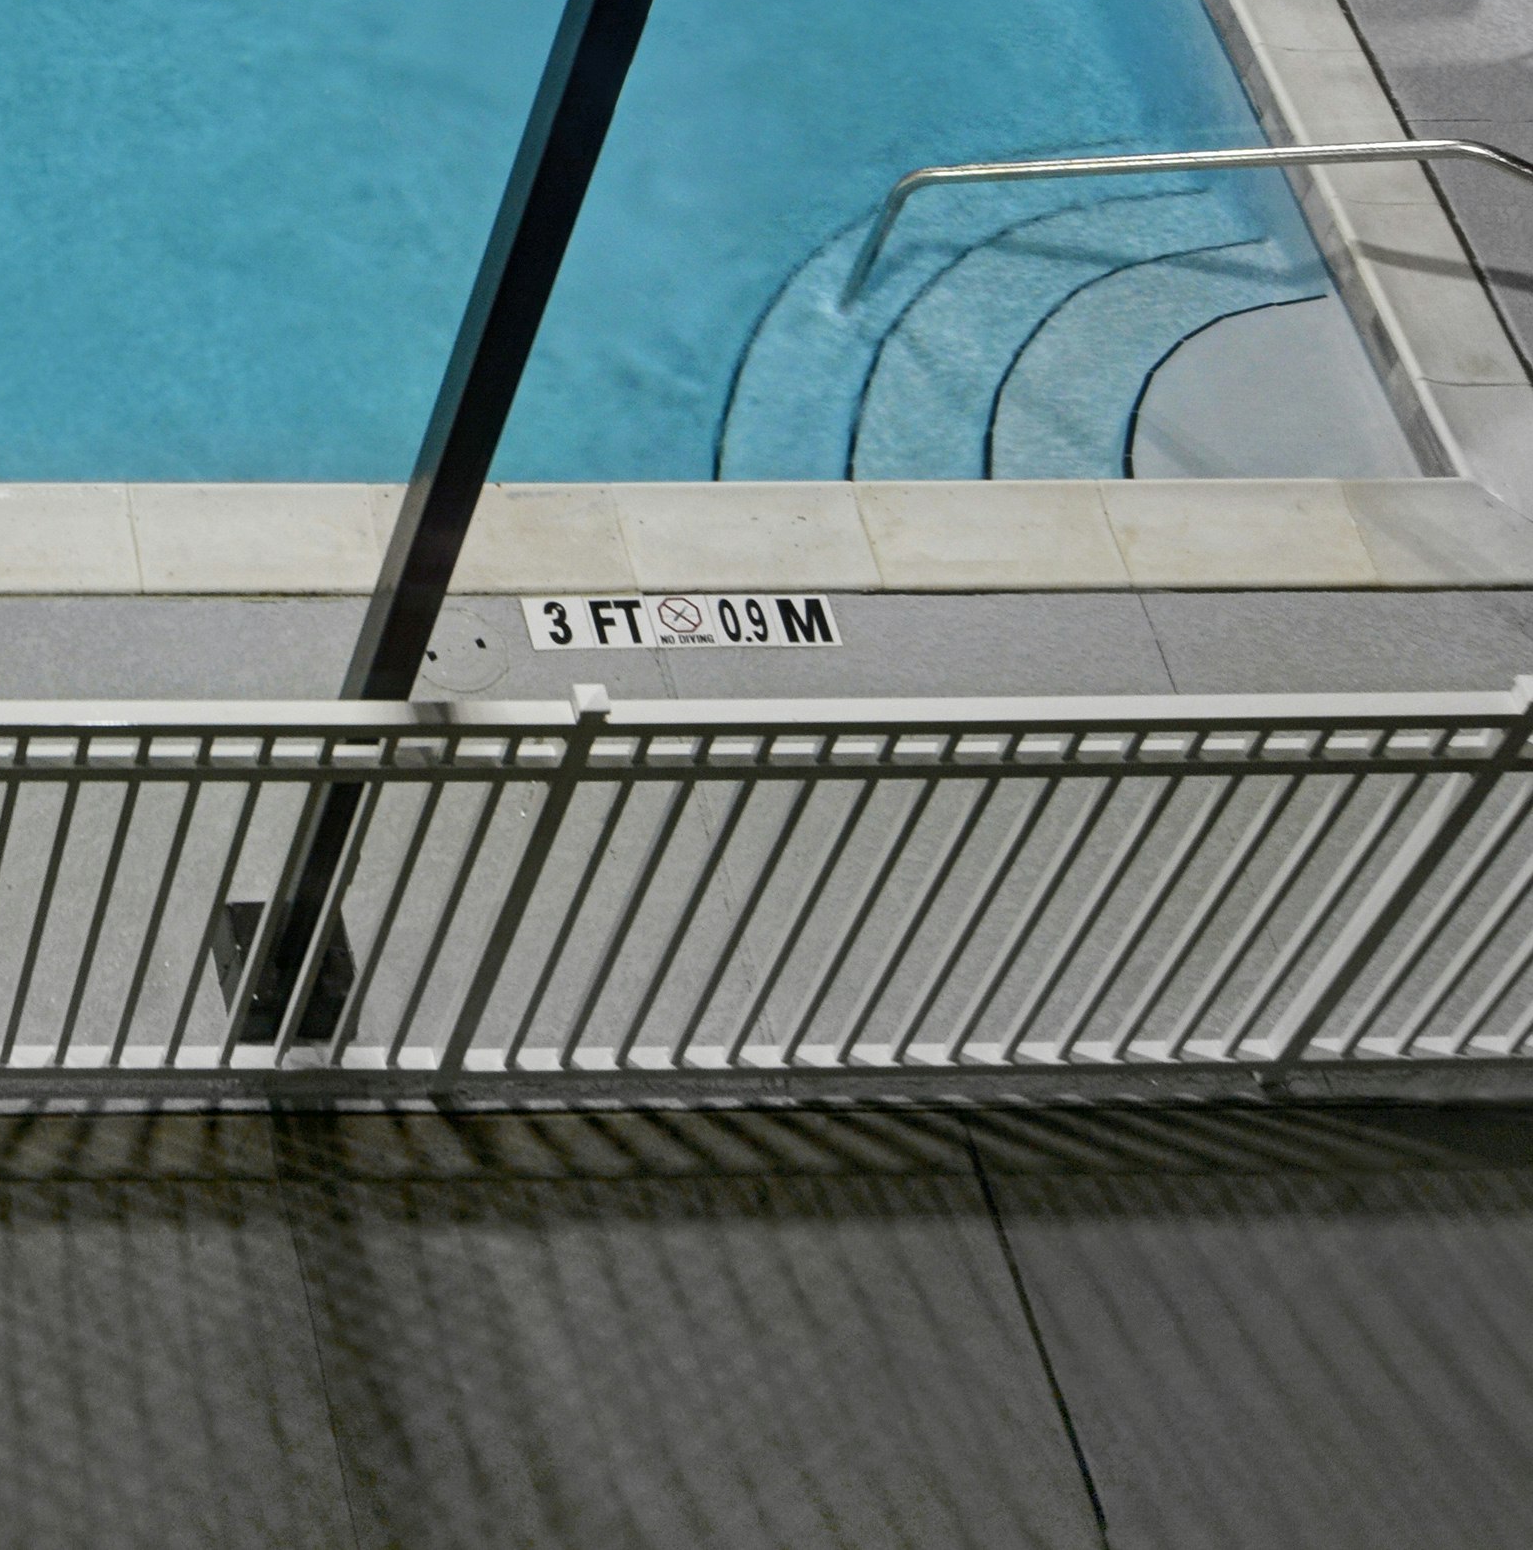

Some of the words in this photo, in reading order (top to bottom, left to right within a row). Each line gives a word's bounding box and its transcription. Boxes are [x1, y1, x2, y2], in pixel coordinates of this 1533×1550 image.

[543, 602, 573, 645] 3
[588, 600, 642, 644] FT
[718, 599, 769, 643] 0.9
[775, 599, 834, 643] M
[660, 634, 675, 644] NO
[678, 634, 715, 644] DIVING
